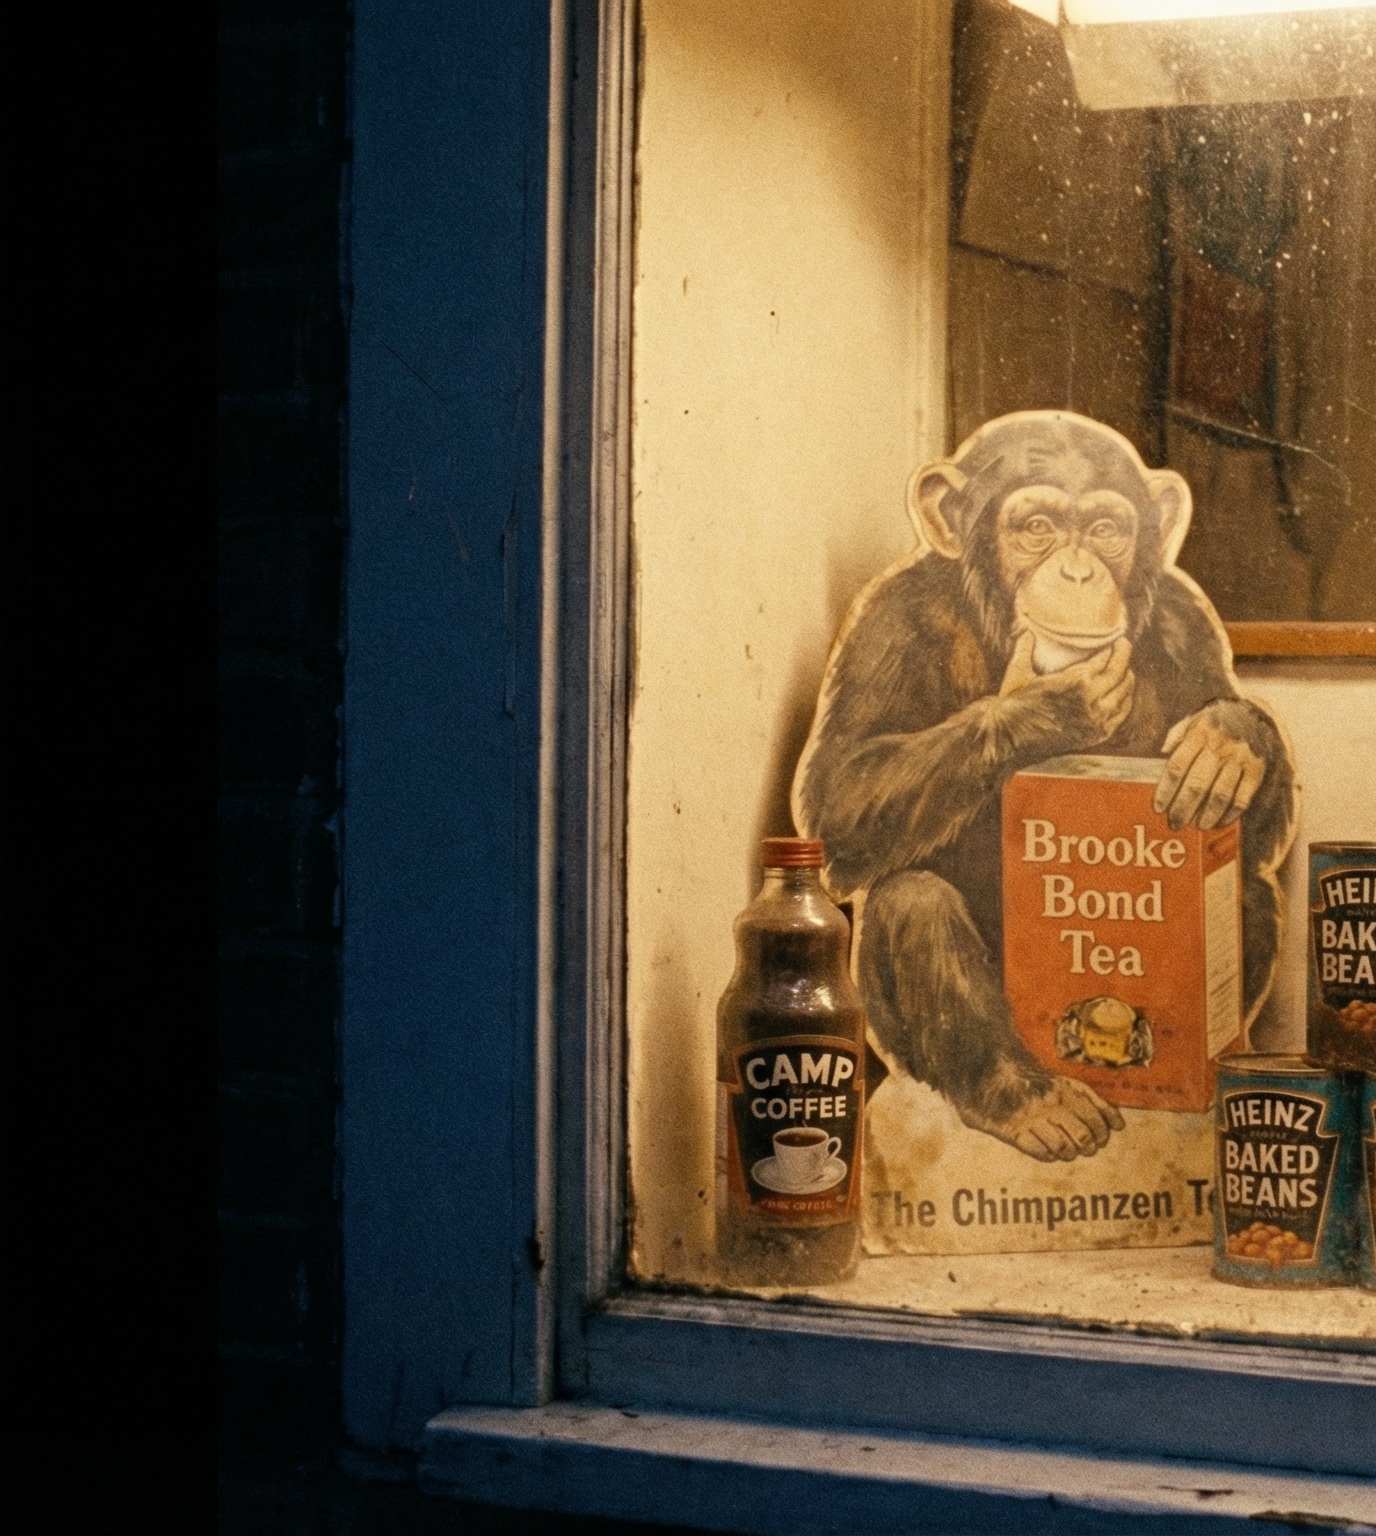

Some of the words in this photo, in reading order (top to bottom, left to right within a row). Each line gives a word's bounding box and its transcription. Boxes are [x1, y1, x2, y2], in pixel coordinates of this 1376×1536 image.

[1022, 818, 1187, 869] Brooke
[1041, 874, 1165, 922] Bond
[1060, 929, 1145, 977] Tea
[746, 1053, 854, 1090] CAMP
[751, 1095, 847, 1120] COFFEE
[1229, 1099, 1316, 1132] HEINZ
[1225, 1139, 1320, 1174] BAKED
[1226, 1173, 1318, 1208] BEANS
[871, 1190, 936, 1228] The
[952, 1187, 1174, 1232] Chimpanzen
